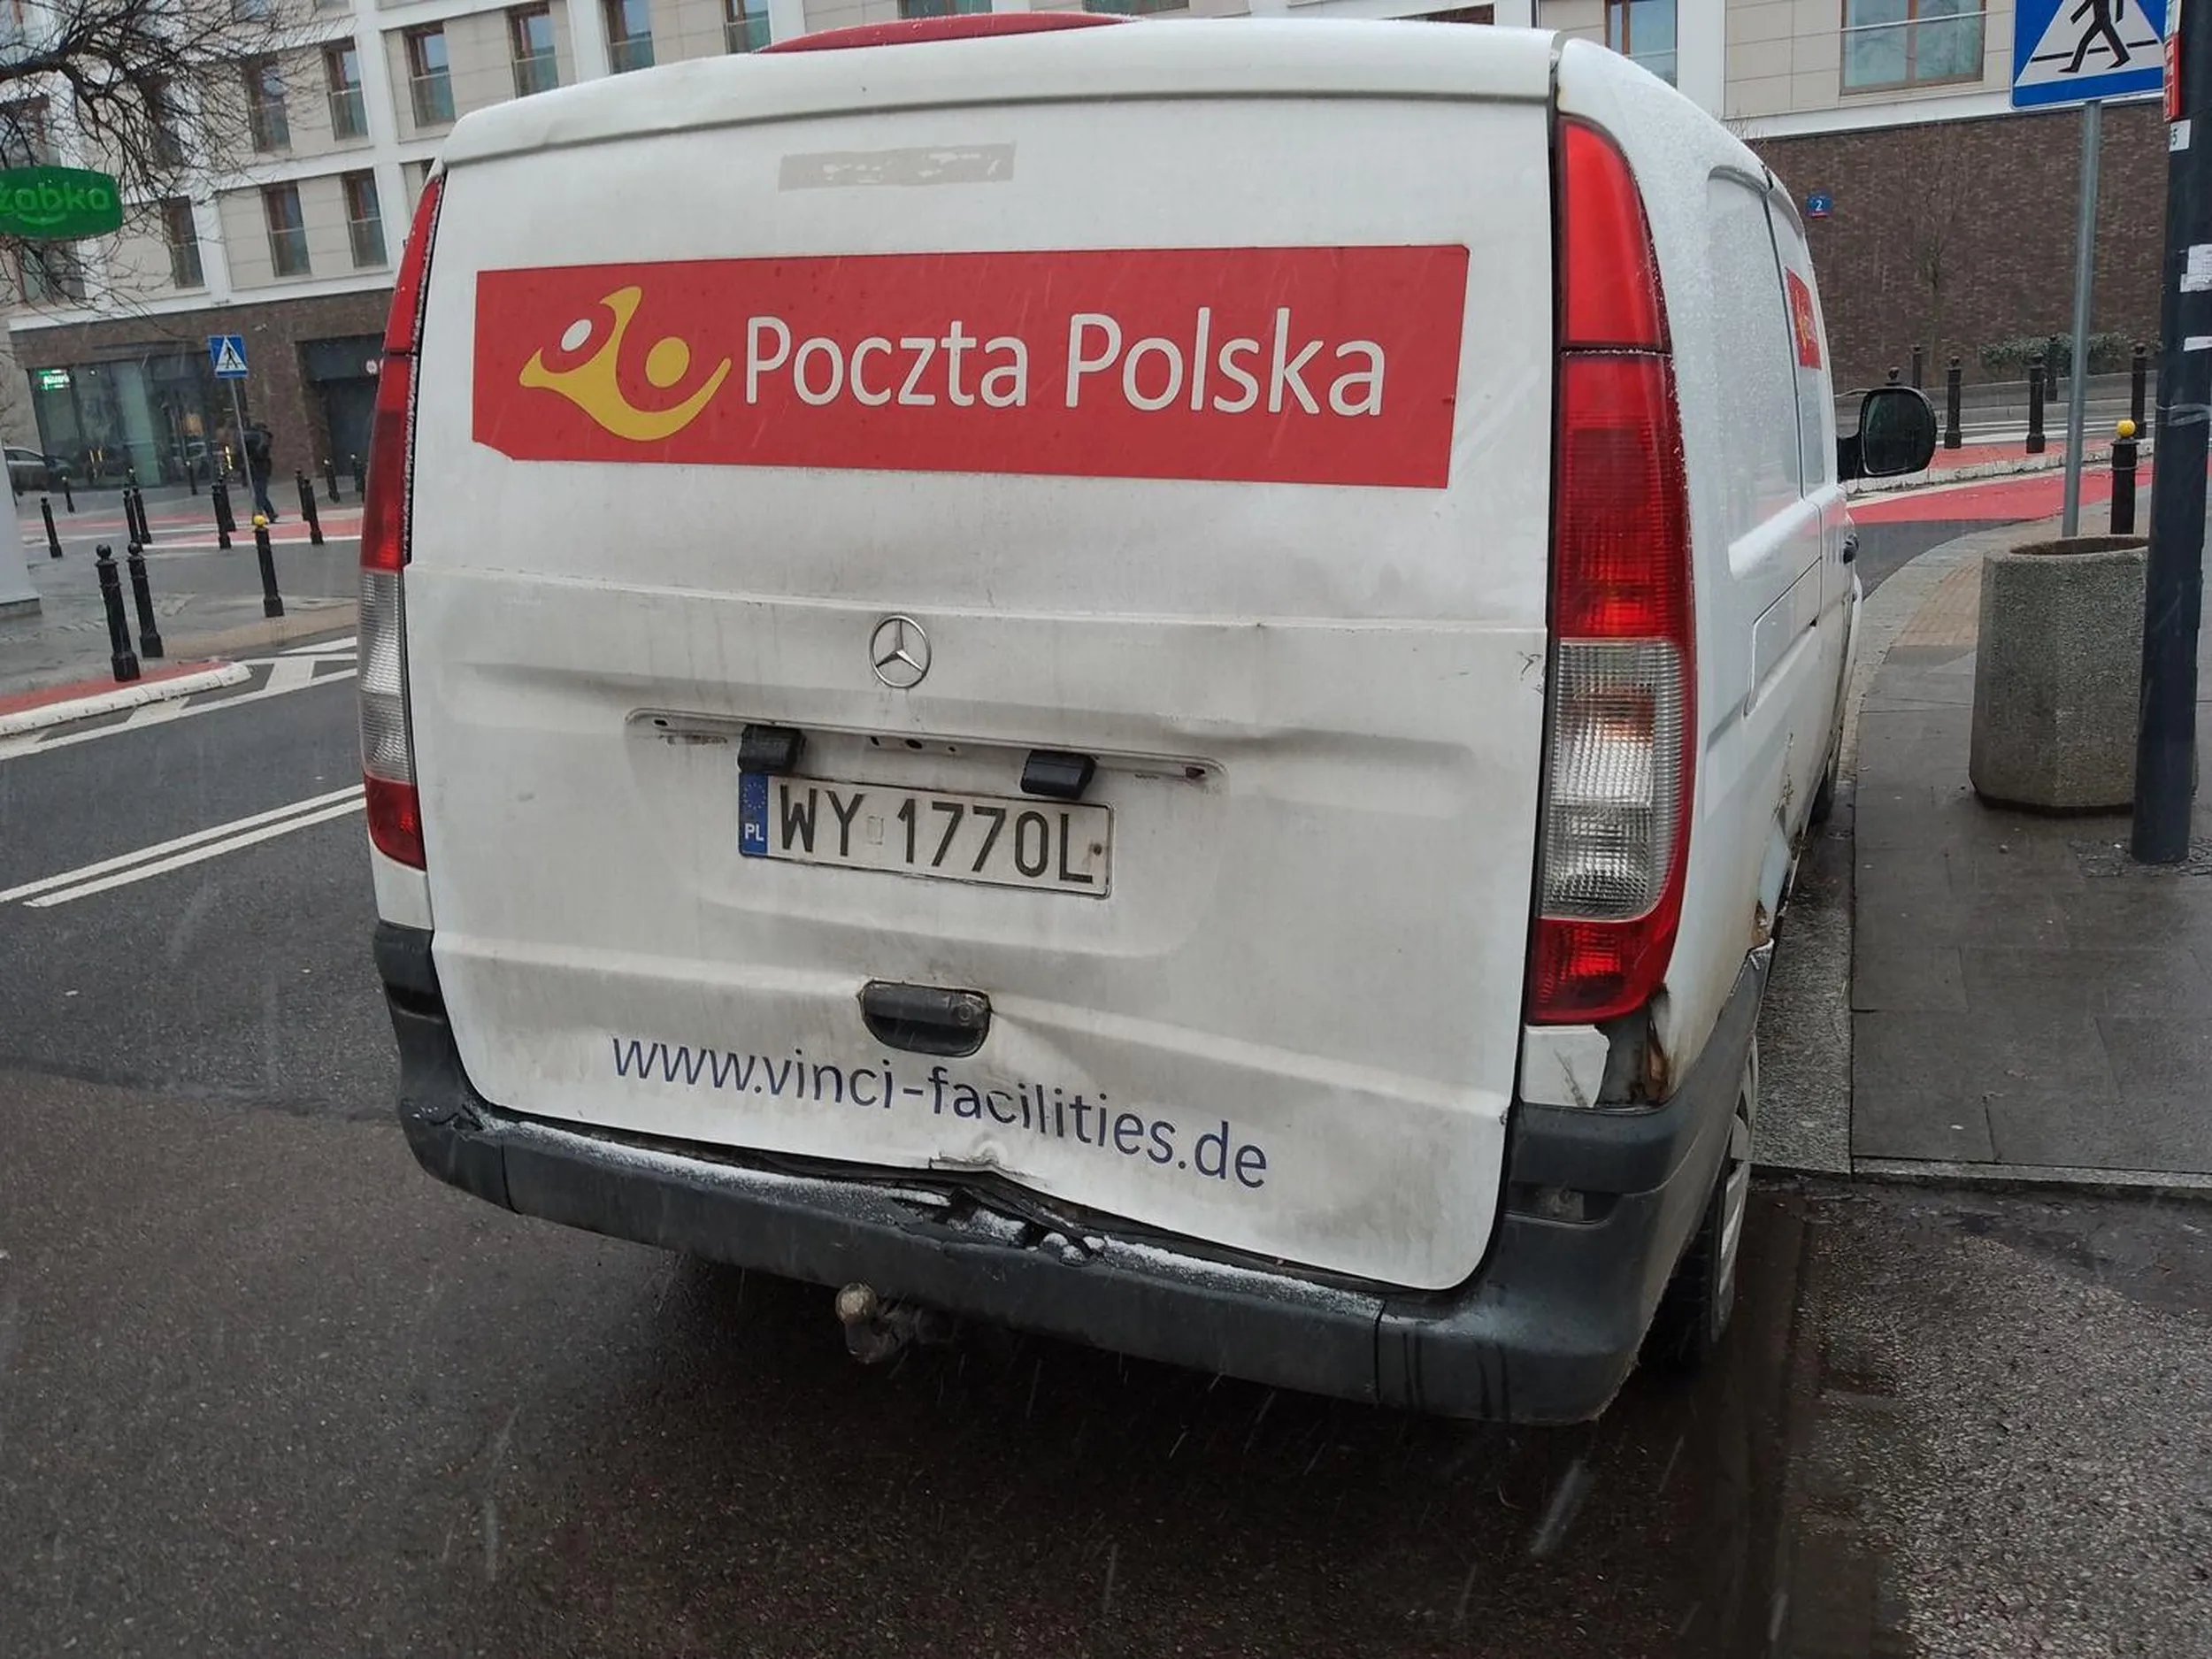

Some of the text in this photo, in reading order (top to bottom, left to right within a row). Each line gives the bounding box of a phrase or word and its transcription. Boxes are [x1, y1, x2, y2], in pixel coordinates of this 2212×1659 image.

[1815, 199, 1823, 211] 2
[746, 306, 1385, 416] Poczta Polska
[744, 823, 764, 842] PL
[780, 785, 1094, 883] WY 1770L
[613, 1038, 1267, 1188] www.vinci-facilities.de
